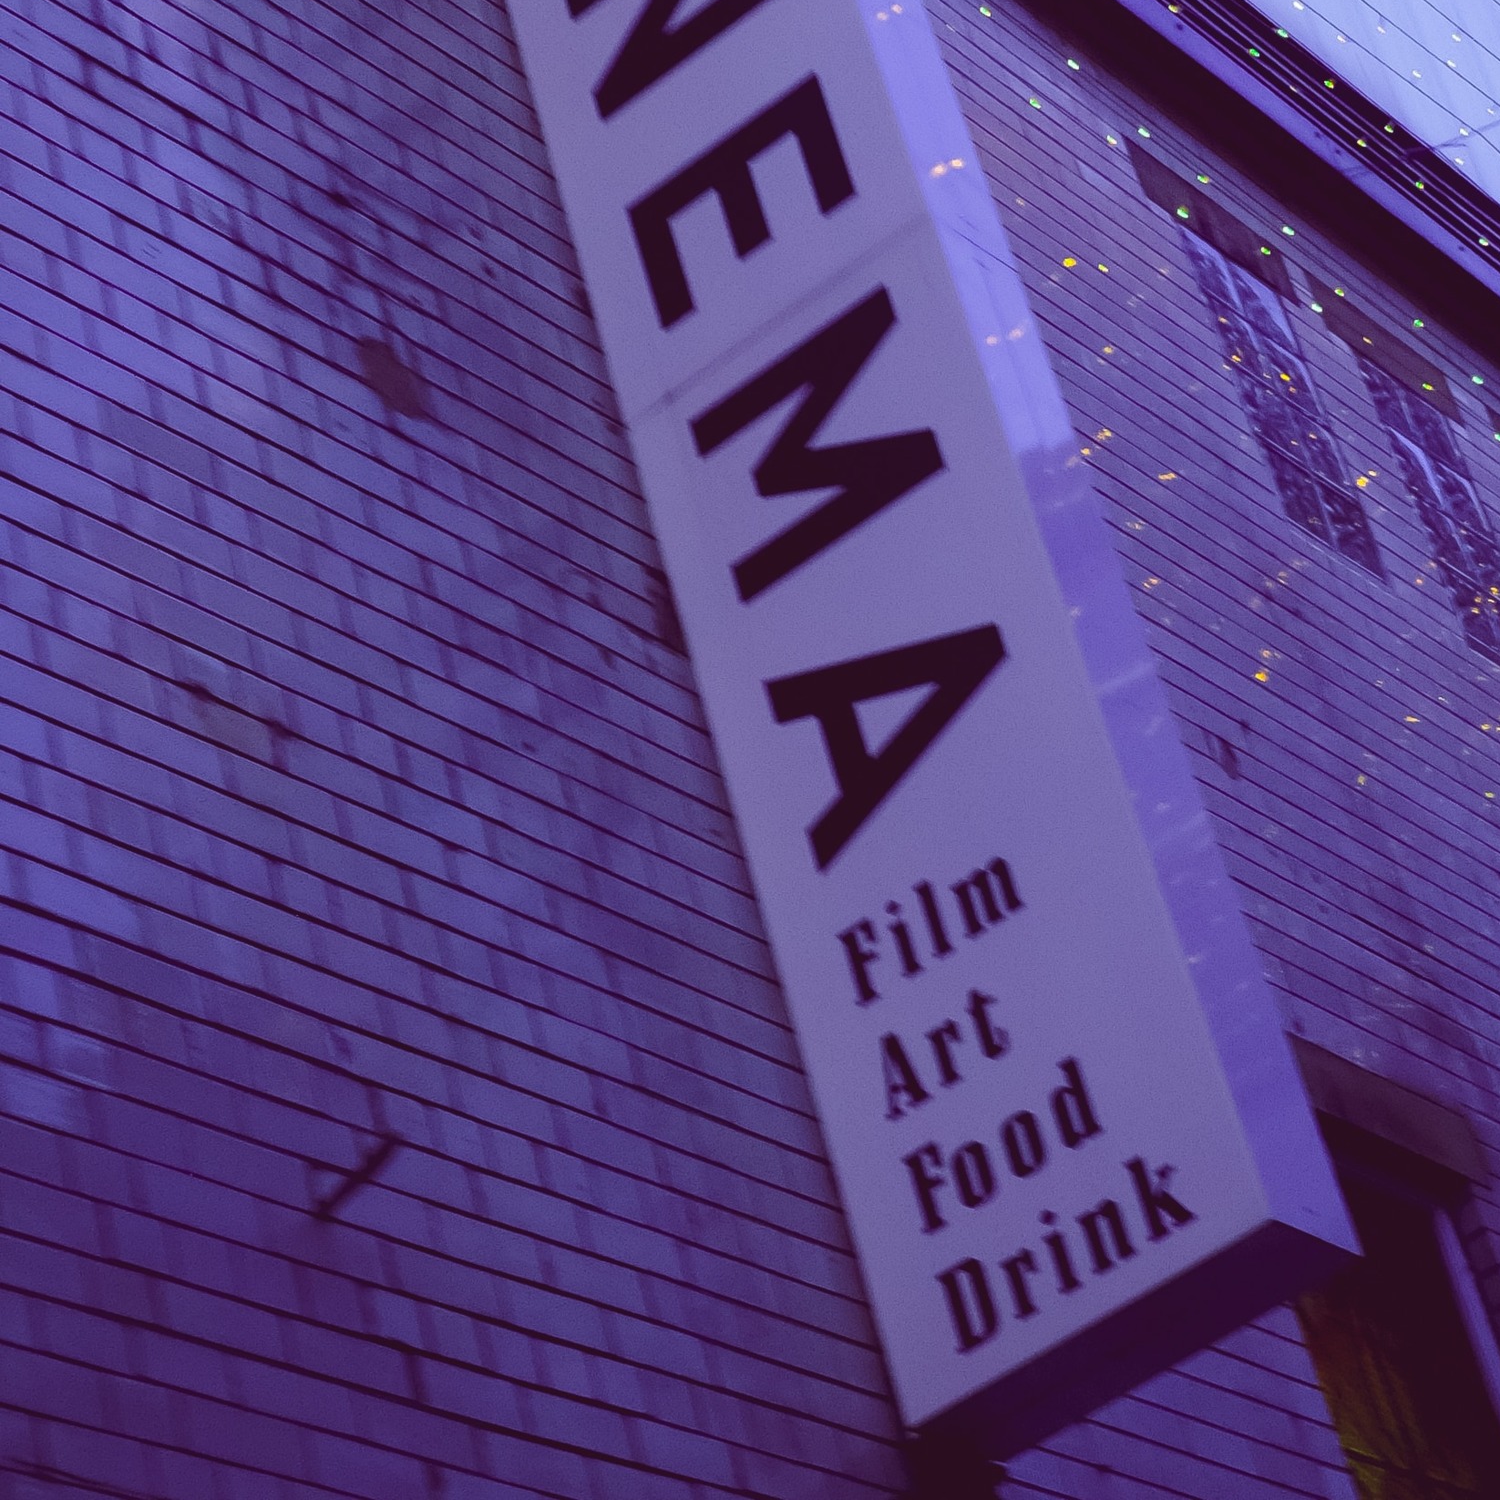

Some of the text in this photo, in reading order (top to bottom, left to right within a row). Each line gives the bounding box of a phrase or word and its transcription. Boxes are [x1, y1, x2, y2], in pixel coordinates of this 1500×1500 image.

[834, 853, 1028, 1010] Film
[878, 986, 1014, 1123] Art
[899, 1053, 1107, 1238] Food
[931, 1151, 1200, 1358] Drink
